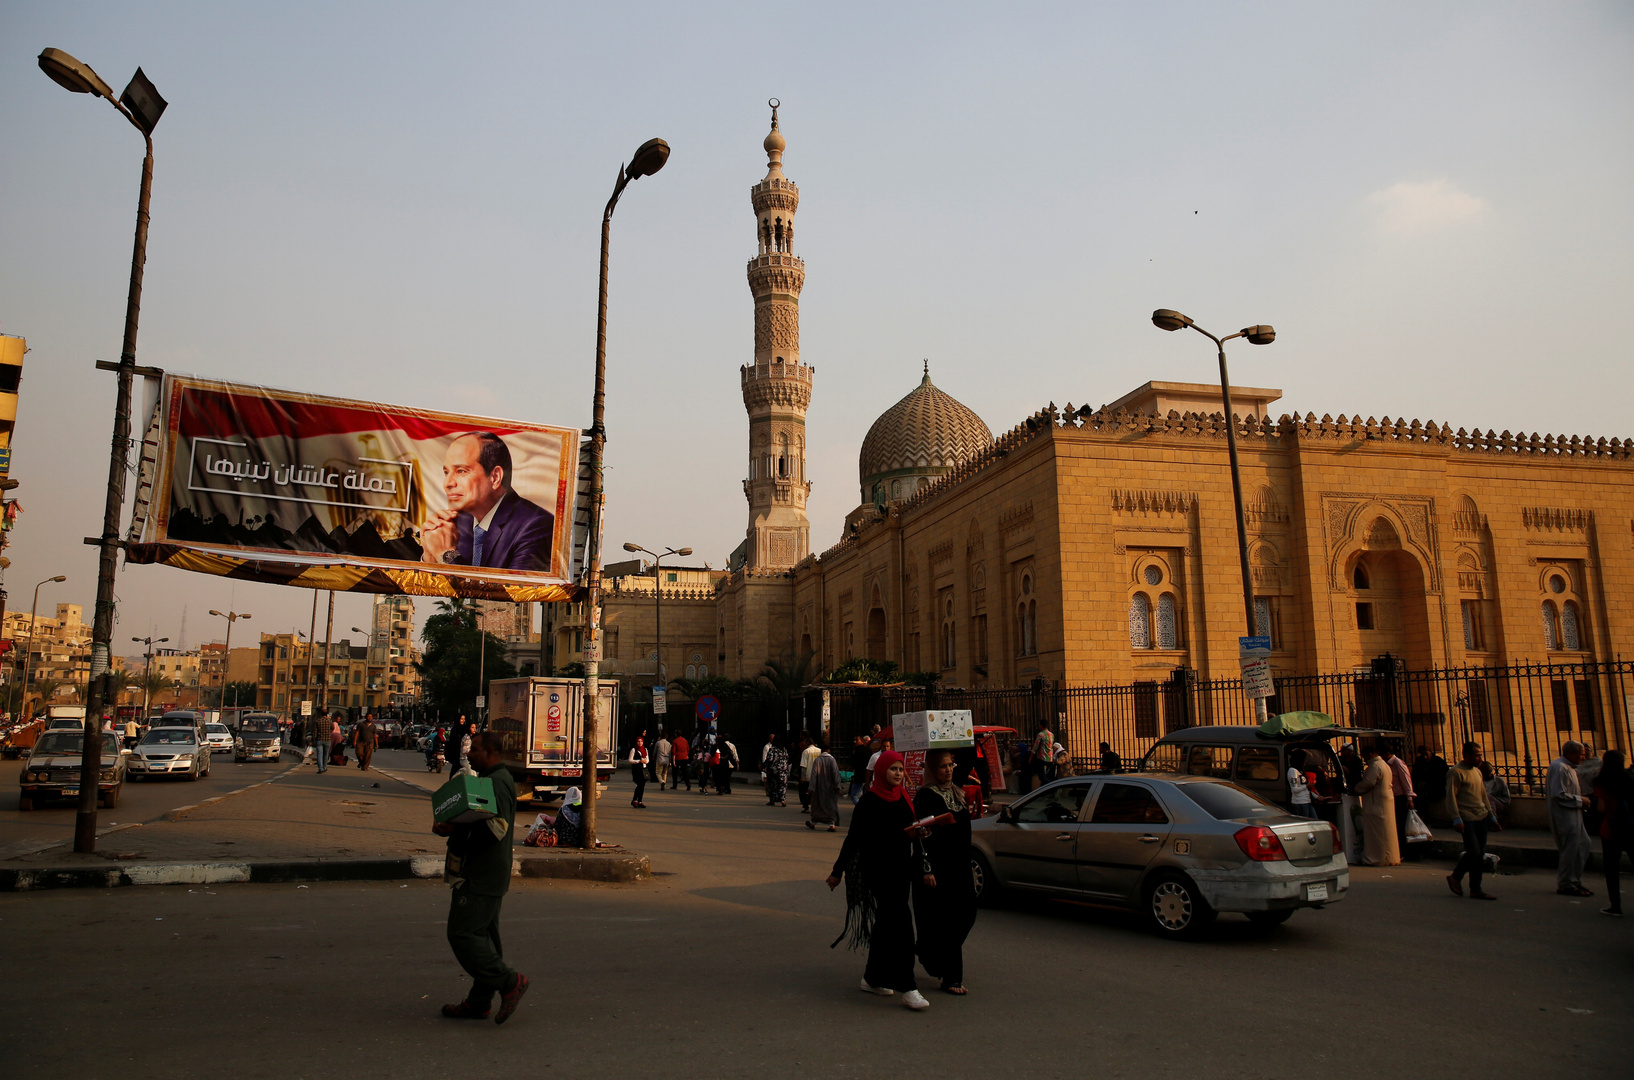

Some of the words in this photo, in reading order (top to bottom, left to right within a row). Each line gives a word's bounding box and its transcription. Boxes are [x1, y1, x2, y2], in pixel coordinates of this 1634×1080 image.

[205, 454, 271, 482] تبنيها
[274, 463, 339, 488] علشان
[343, 469, 397, 494] حملة
